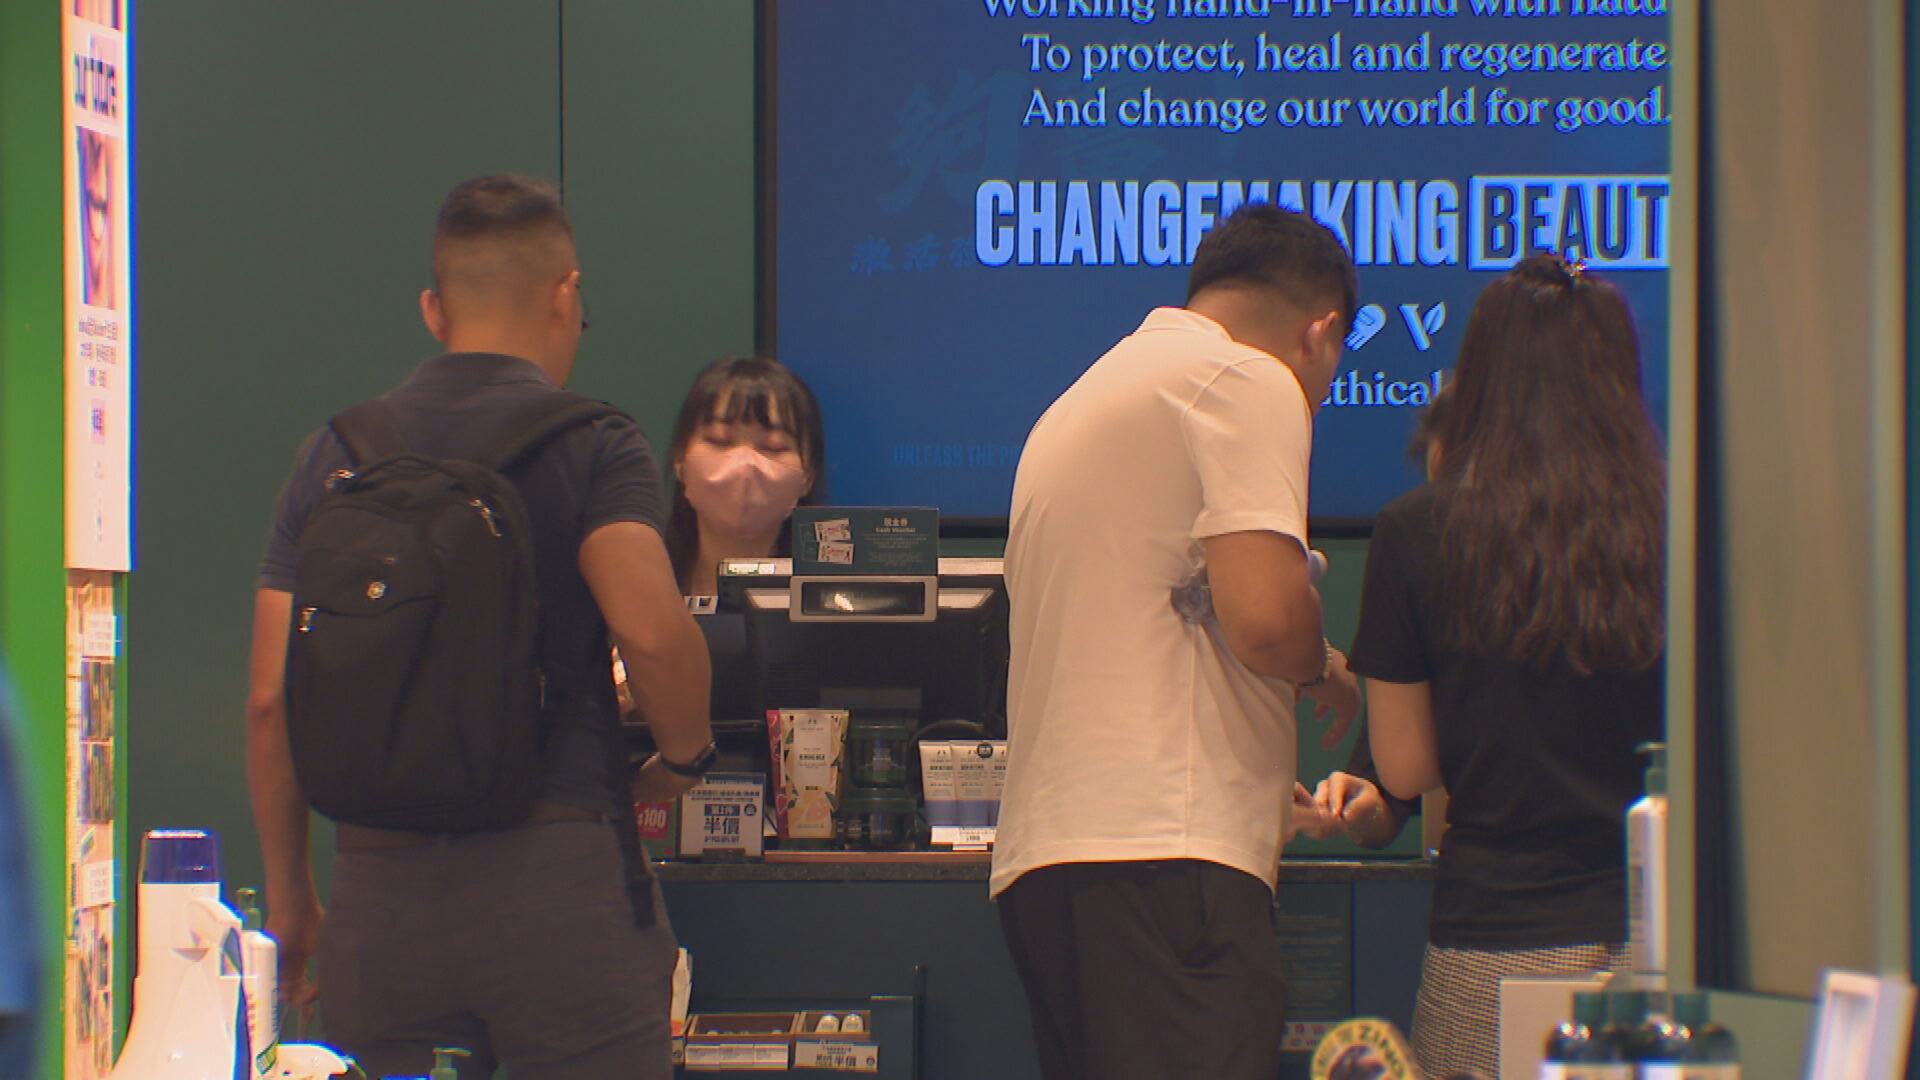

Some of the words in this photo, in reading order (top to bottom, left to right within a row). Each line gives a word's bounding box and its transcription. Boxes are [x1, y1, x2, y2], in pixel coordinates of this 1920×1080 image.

[1021, 32, 1071, 72] To
[1082, 38, 1244, 80] protect,
[1255, 31, 1341, 72] heal
[1352, 31, 1431, 72] and
[1021, 87, 1107, 127] And
[1117, 86, 1268, 133] change
[1277, 97, 1350, 127] our
[1358, 86, 1477, 127] world
[1485, 86, 1549, 127] for
[1555, 86, 1671, 133] good.
[1482, 183, 1670, 262] BEAUT
[1320, 369, 1442, 407] thical
[704, 817, 740, 835] 半價
